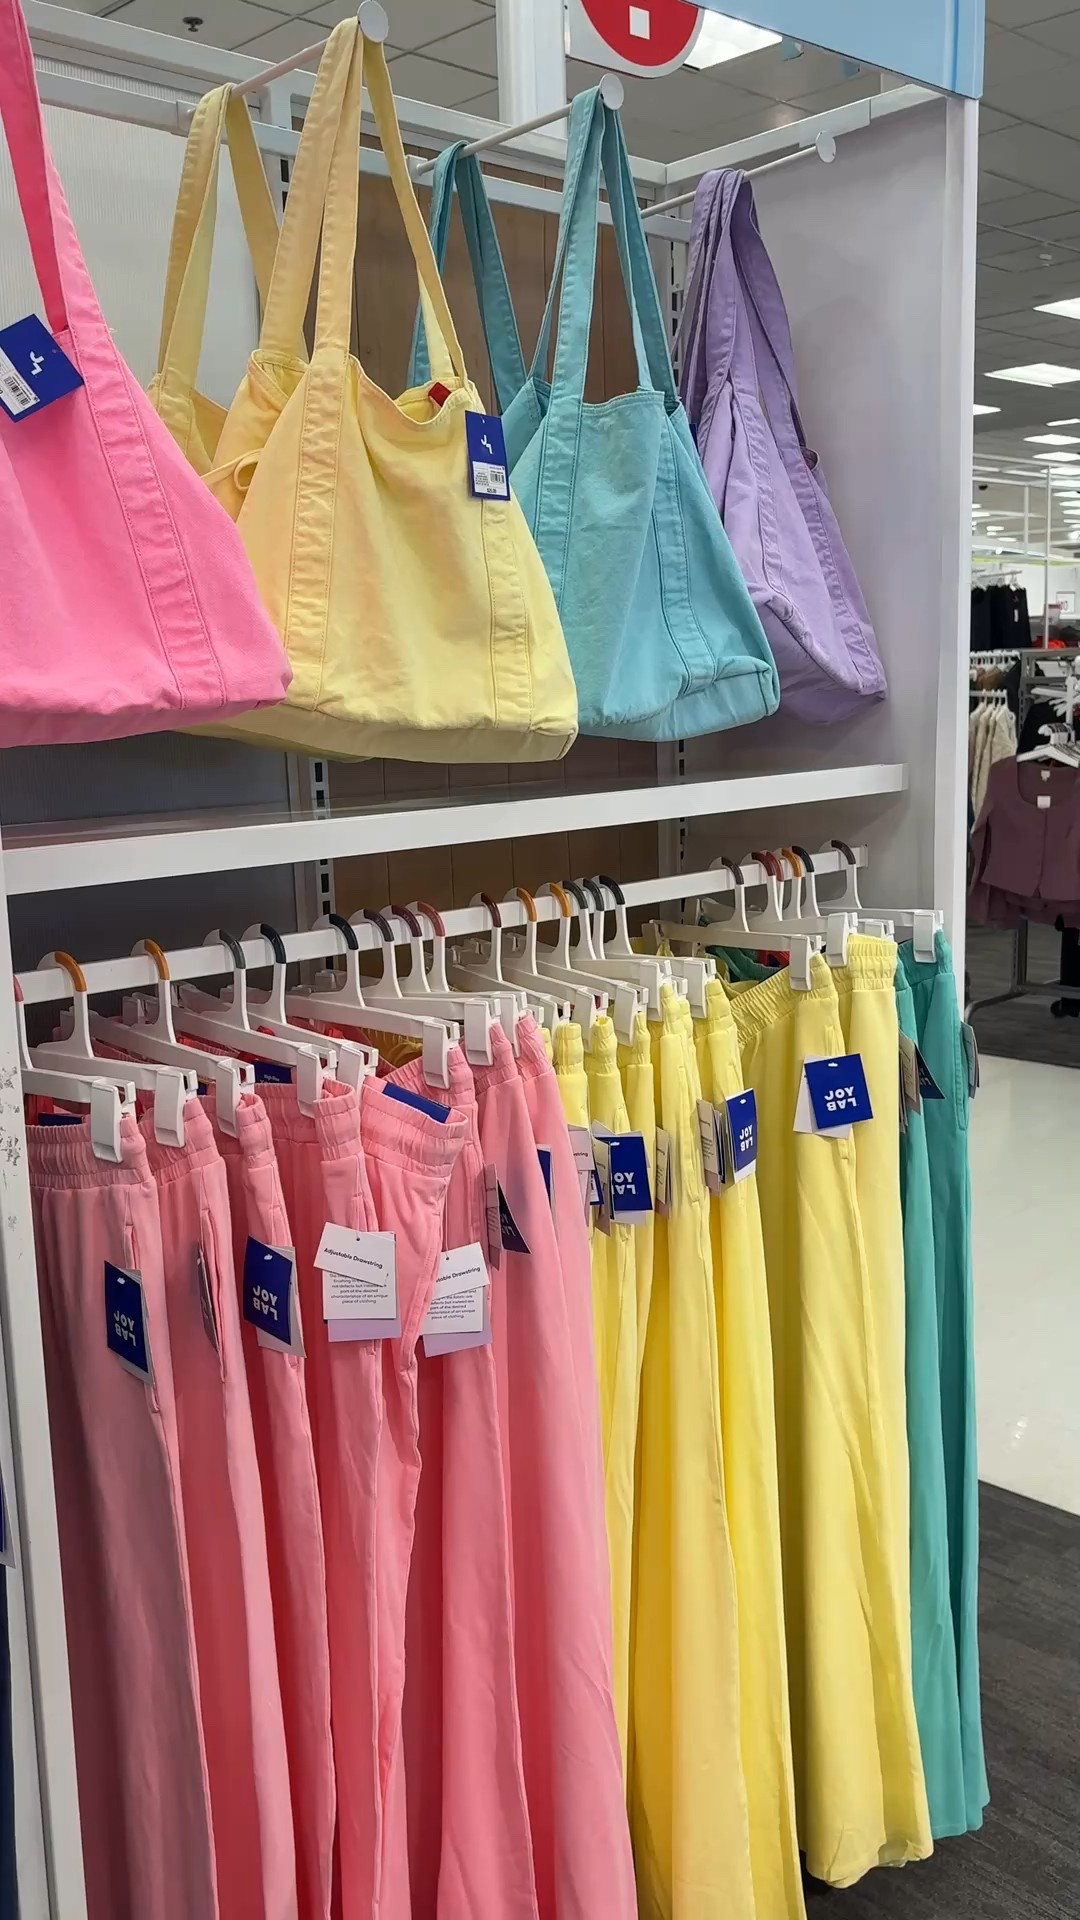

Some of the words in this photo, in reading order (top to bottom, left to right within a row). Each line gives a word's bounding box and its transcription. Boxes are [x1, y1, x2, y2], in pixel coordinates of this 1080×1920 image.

[824, 1086, 854, 1101] JOY
[826, 1097, 857, 1111] LAB
[739, 1124, 753, 1140] JOY
[740, 1136, 753, 1152] LAB
[613, 1172, 634, 1183] OY
[612, 1184, 636, 1195] LA
[324, 1248, 352, 1259] Adjustable
[353, 1255, 382, 1270] Drawstring
[452, 1267, 480, 1278] Drawstring
[253, 1285, 278, 1306] JOY
[253, 1297, 278, 1321] LAB
[114, 1310, 135, 1332] JOY
[115, 1323, 136, 1347] LAB
